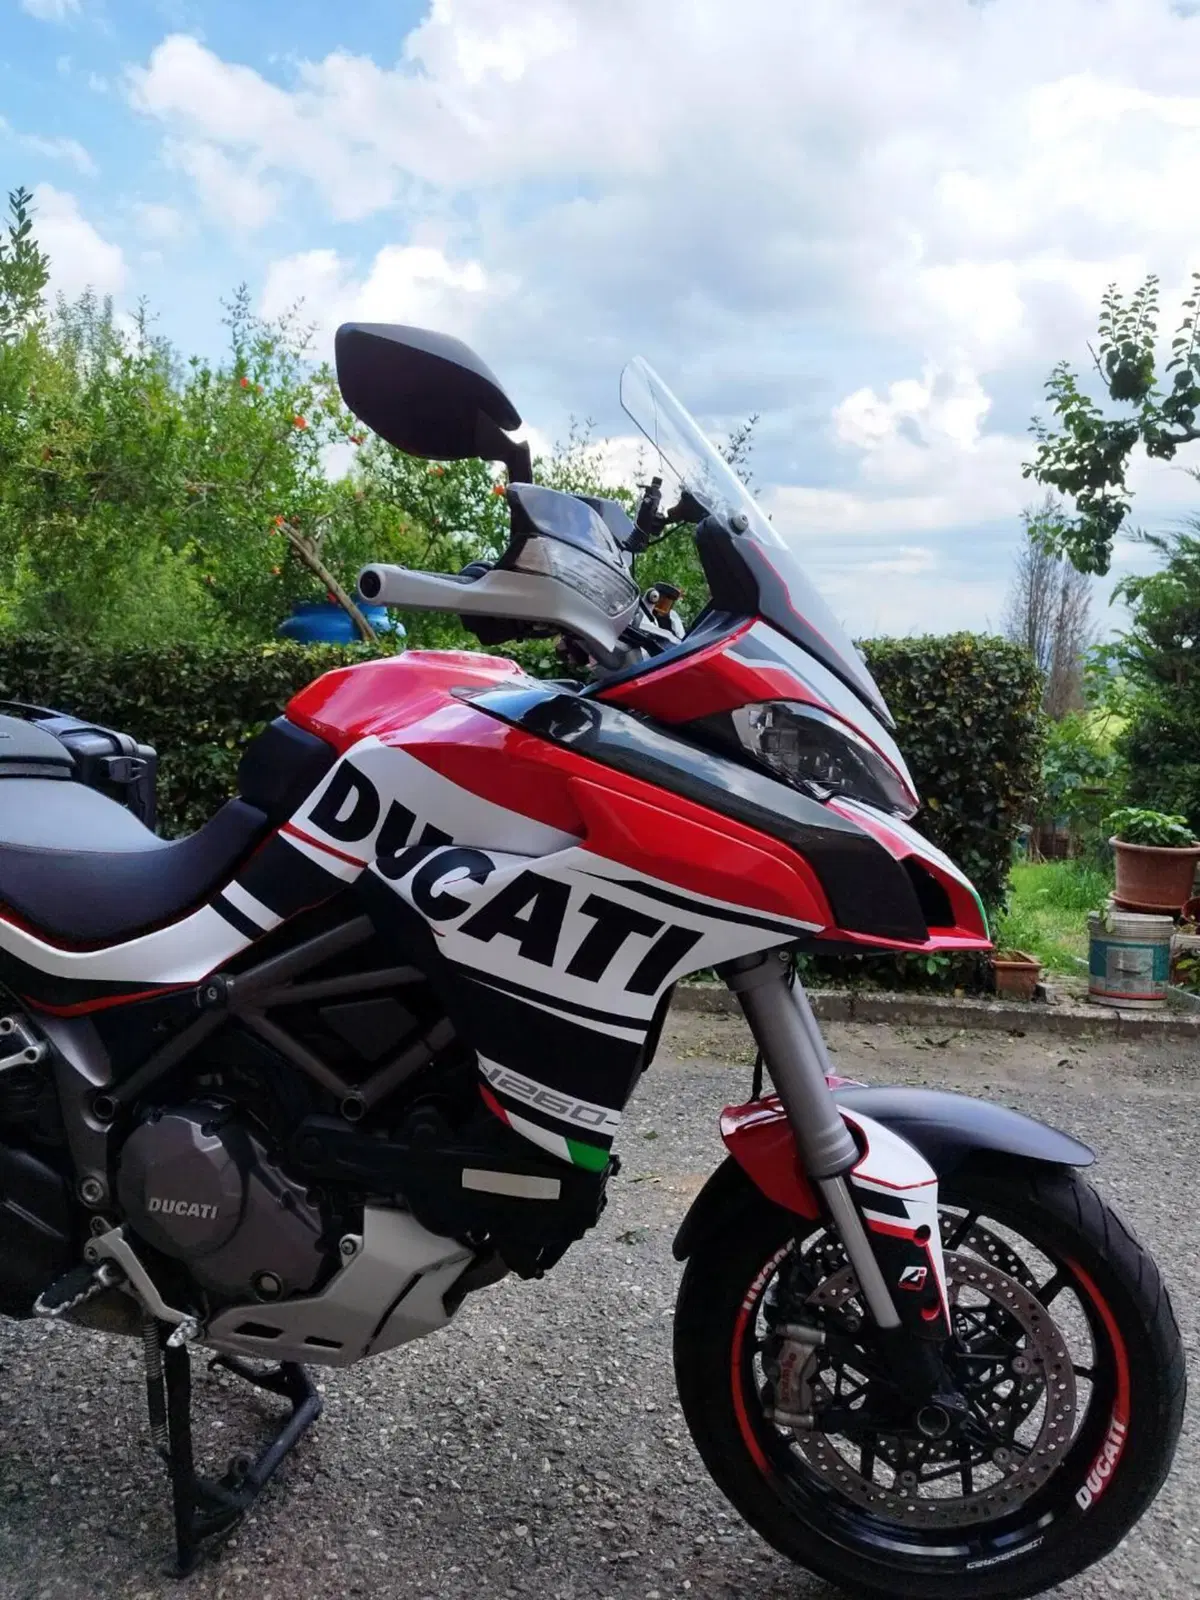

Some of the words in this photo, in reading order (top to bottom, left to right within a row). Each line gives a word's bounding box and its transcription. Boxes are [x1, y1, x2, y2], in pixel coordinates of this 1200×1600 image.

[307, 759, 704, 996] DUCATI
[488, 1068, 608, 1125] 1260
[148, 1197, 218, 1219] DUCATI
[1075, 1416, 1125, 1510] DUCATI
